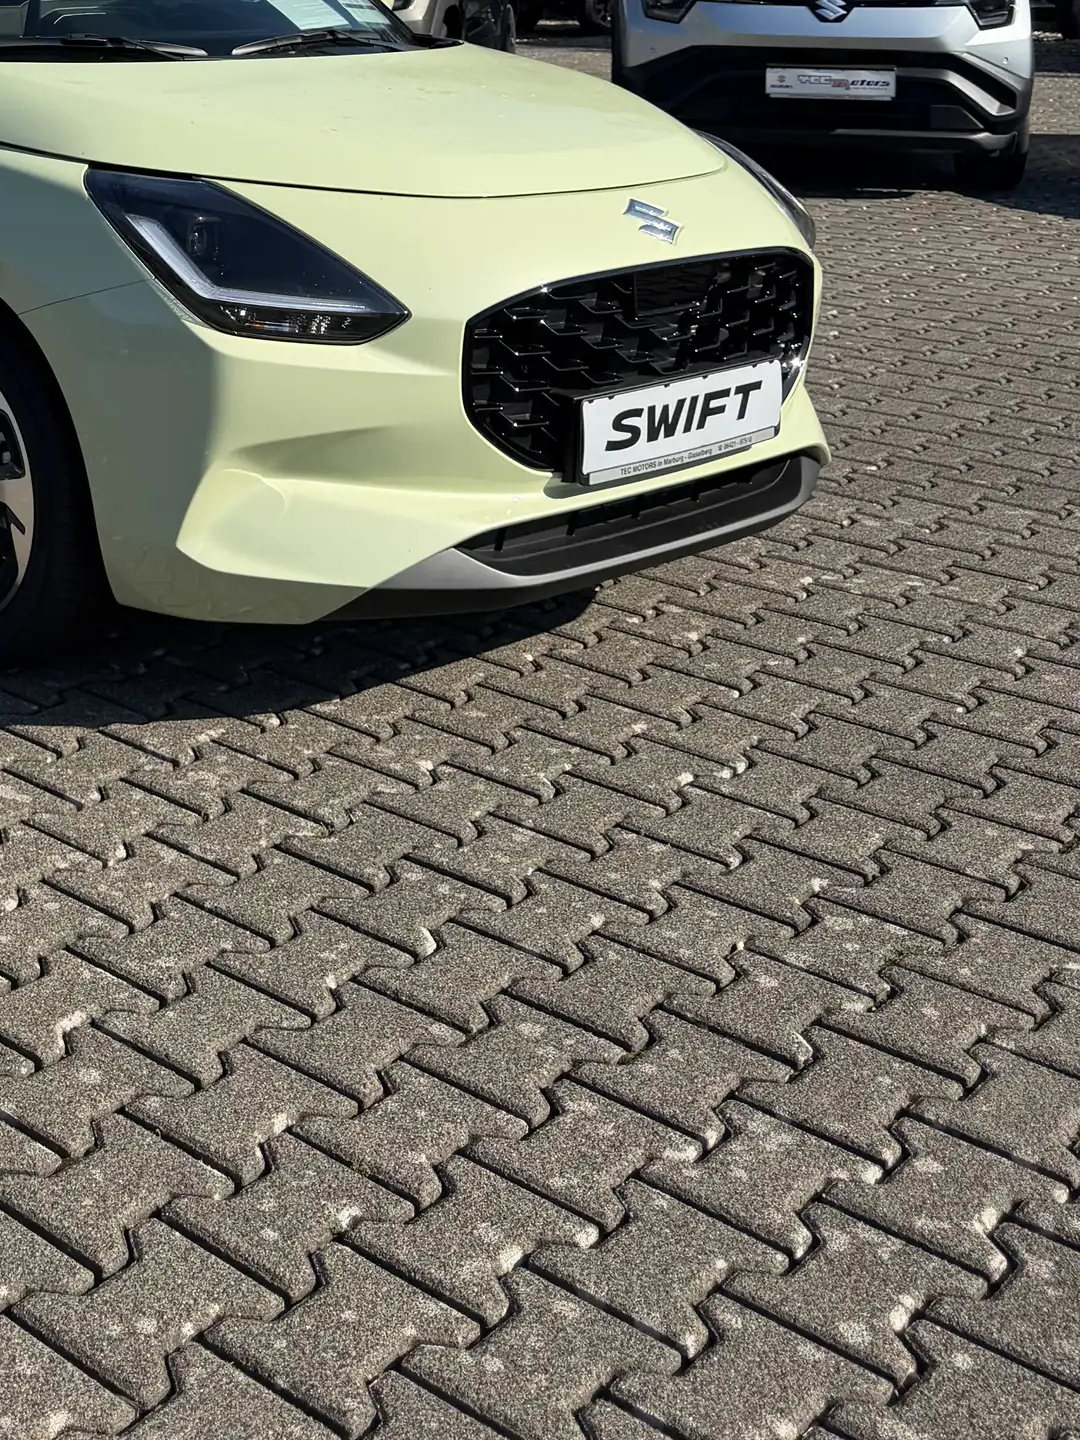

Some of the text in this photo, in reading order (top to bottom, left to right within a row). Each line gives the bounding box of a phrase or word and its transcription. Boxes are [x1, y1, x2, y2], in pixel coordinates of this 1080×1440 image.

[604, 379, 763, 452] SWIFT
[620, 467, 632, 476] TEC
[632, 462, 657, 473] MOTORS
[663, 455, 684, 466] Marburg
